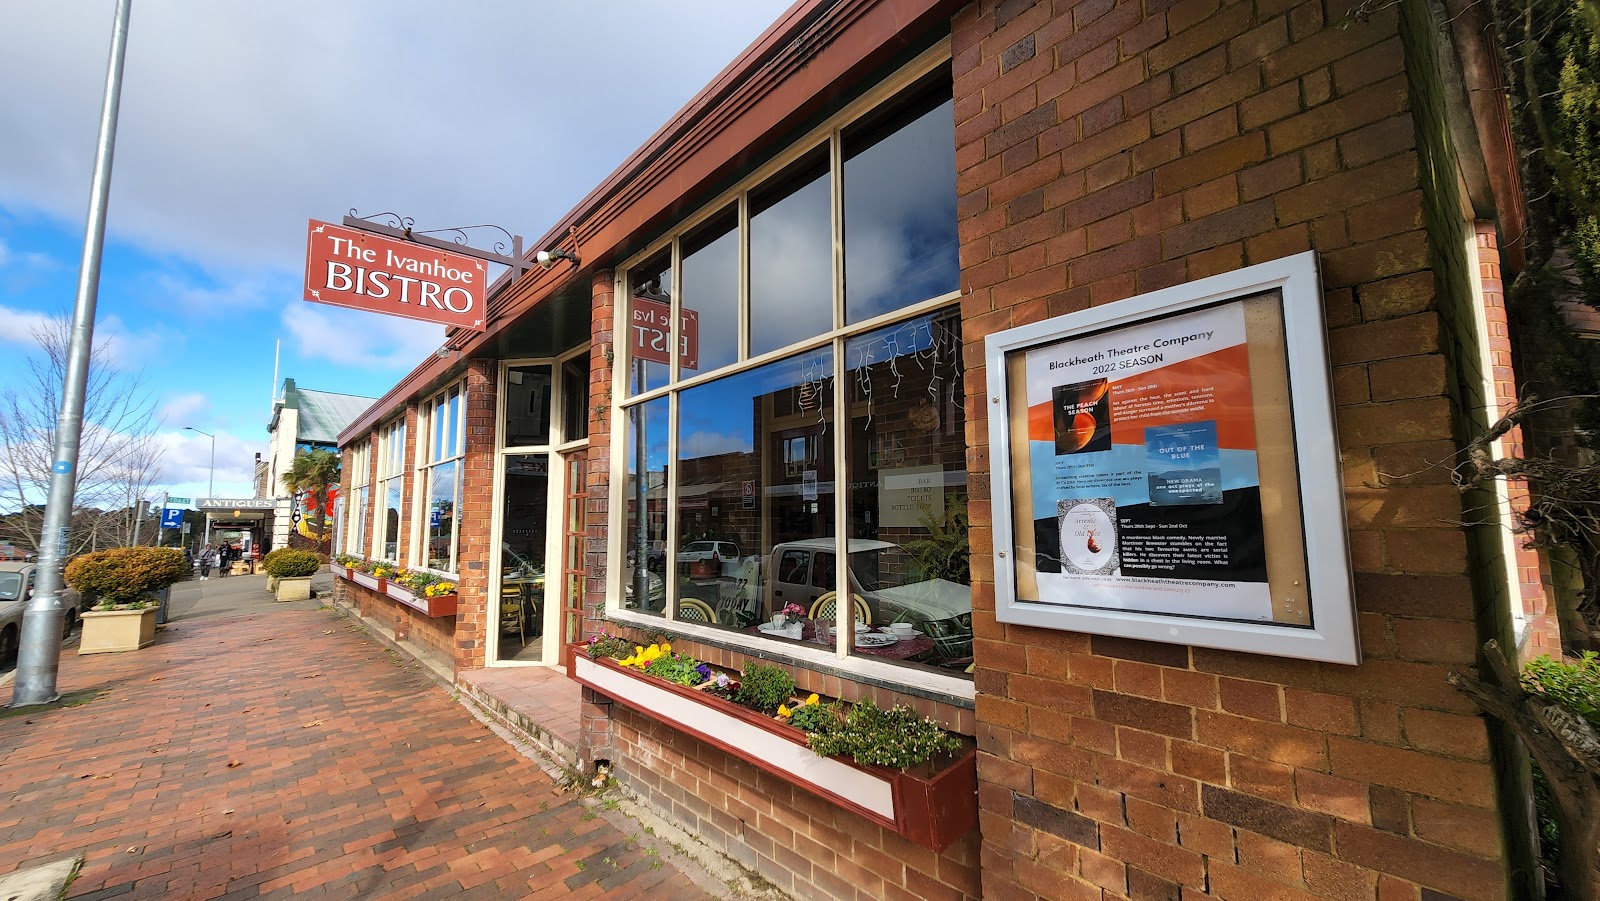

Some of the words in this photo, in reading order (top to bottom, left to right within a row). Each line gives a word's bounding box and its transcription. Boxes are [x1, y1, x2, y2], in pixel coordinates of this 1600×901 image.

[328, 236, 376, 262] The
[387, 250, 472, 283] Ivanhoe
[325, 260, 474, 314] BISTRO
[1049, 352, 1104, 370] Blackheath
[1107, 343, 1150, 357] Theatre
[1153, 330, 1214, 348] Company
[1092, 362, 1116, 375] 2022
[1119, 353, 1163, 370] SEASON
[1068, 407, 1093, 415] SEASON
[168, 510, 179, 519] P
[1116, 578, 1235, 588] www.blackheaththeatrecompany.com
[720, 597, 749, 610] TODAY
